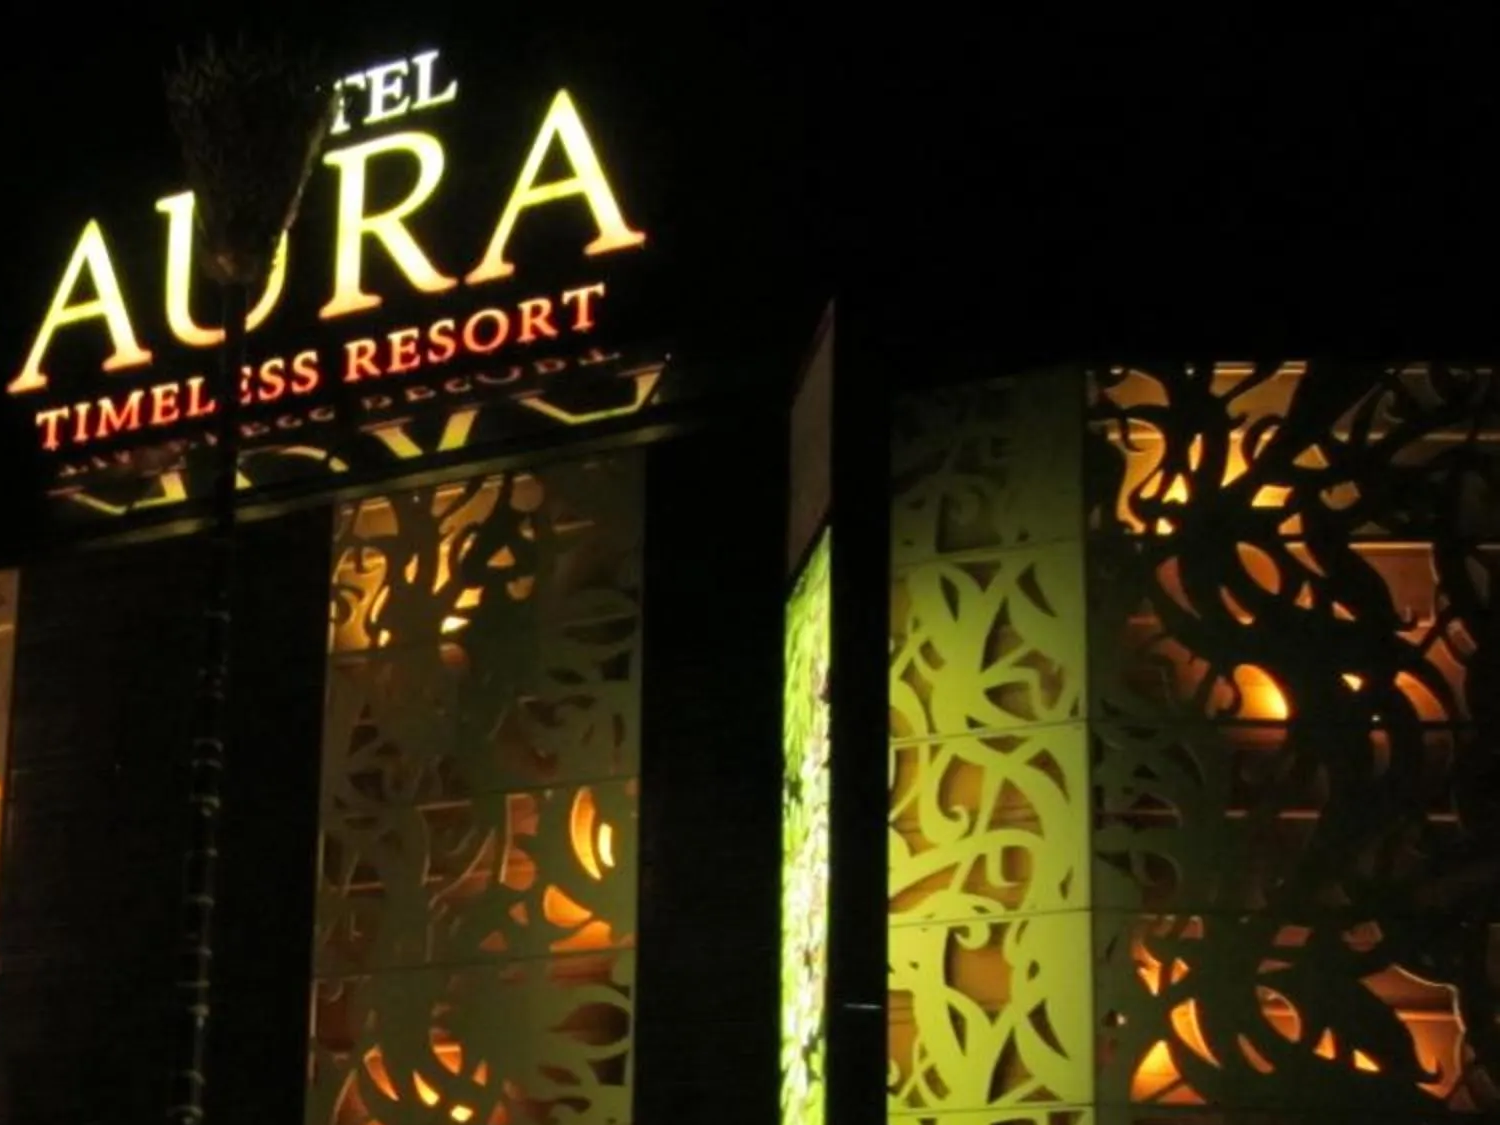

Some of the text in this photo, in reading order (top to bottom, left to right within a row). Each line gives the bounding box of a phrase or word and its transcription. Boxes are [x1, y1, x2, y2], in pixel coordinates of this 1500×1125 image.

[329, 49, 459, 135] TEL
[6, 87, 647, 396] AURA
[343, 283, 606, 384] RESORT
